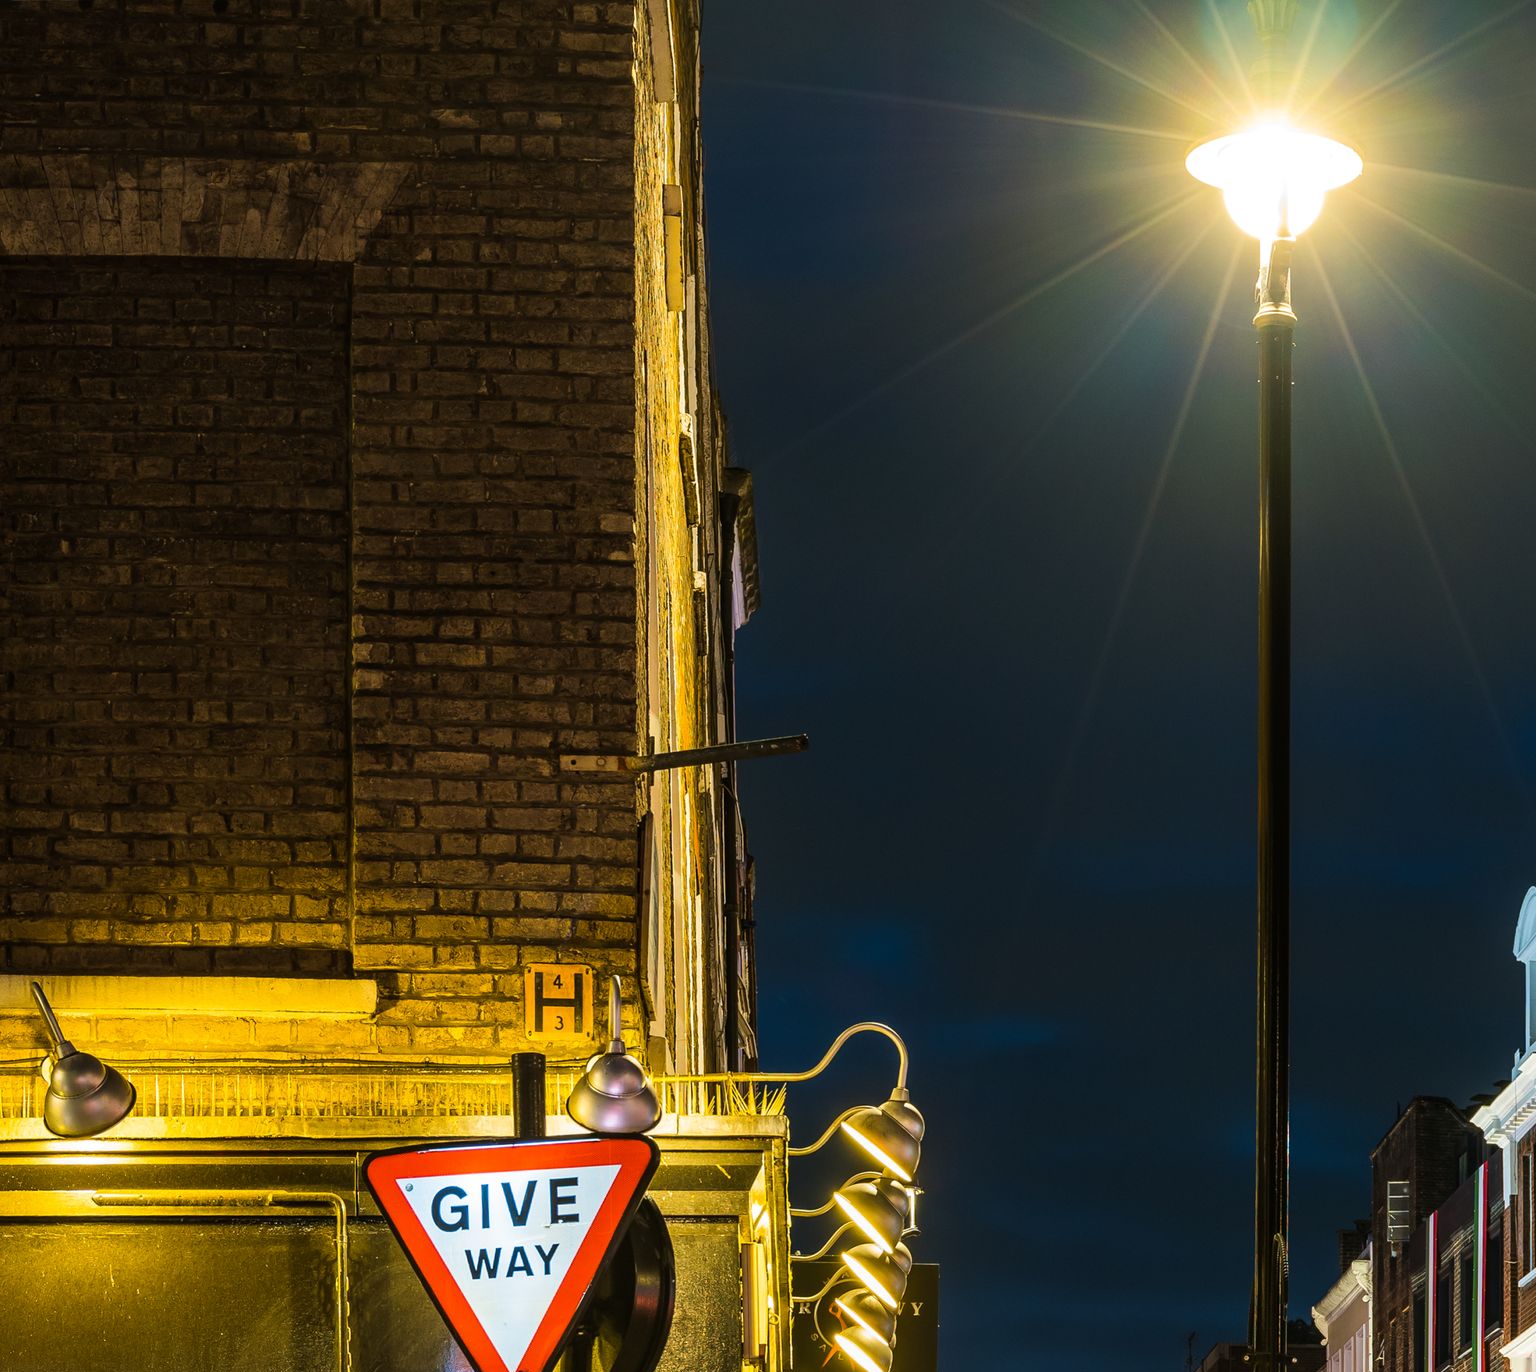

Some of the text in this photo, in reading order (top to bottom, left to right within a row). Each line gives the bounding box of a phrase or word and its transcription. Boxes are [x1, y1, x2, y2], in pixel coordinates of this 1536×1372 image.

[553, 974, 563, 989] 4
[554, 1015, 564, 1030] 3
[431, 1176, 581, 1235] GIVE
[465, 1244, 562, 1282] WAY
